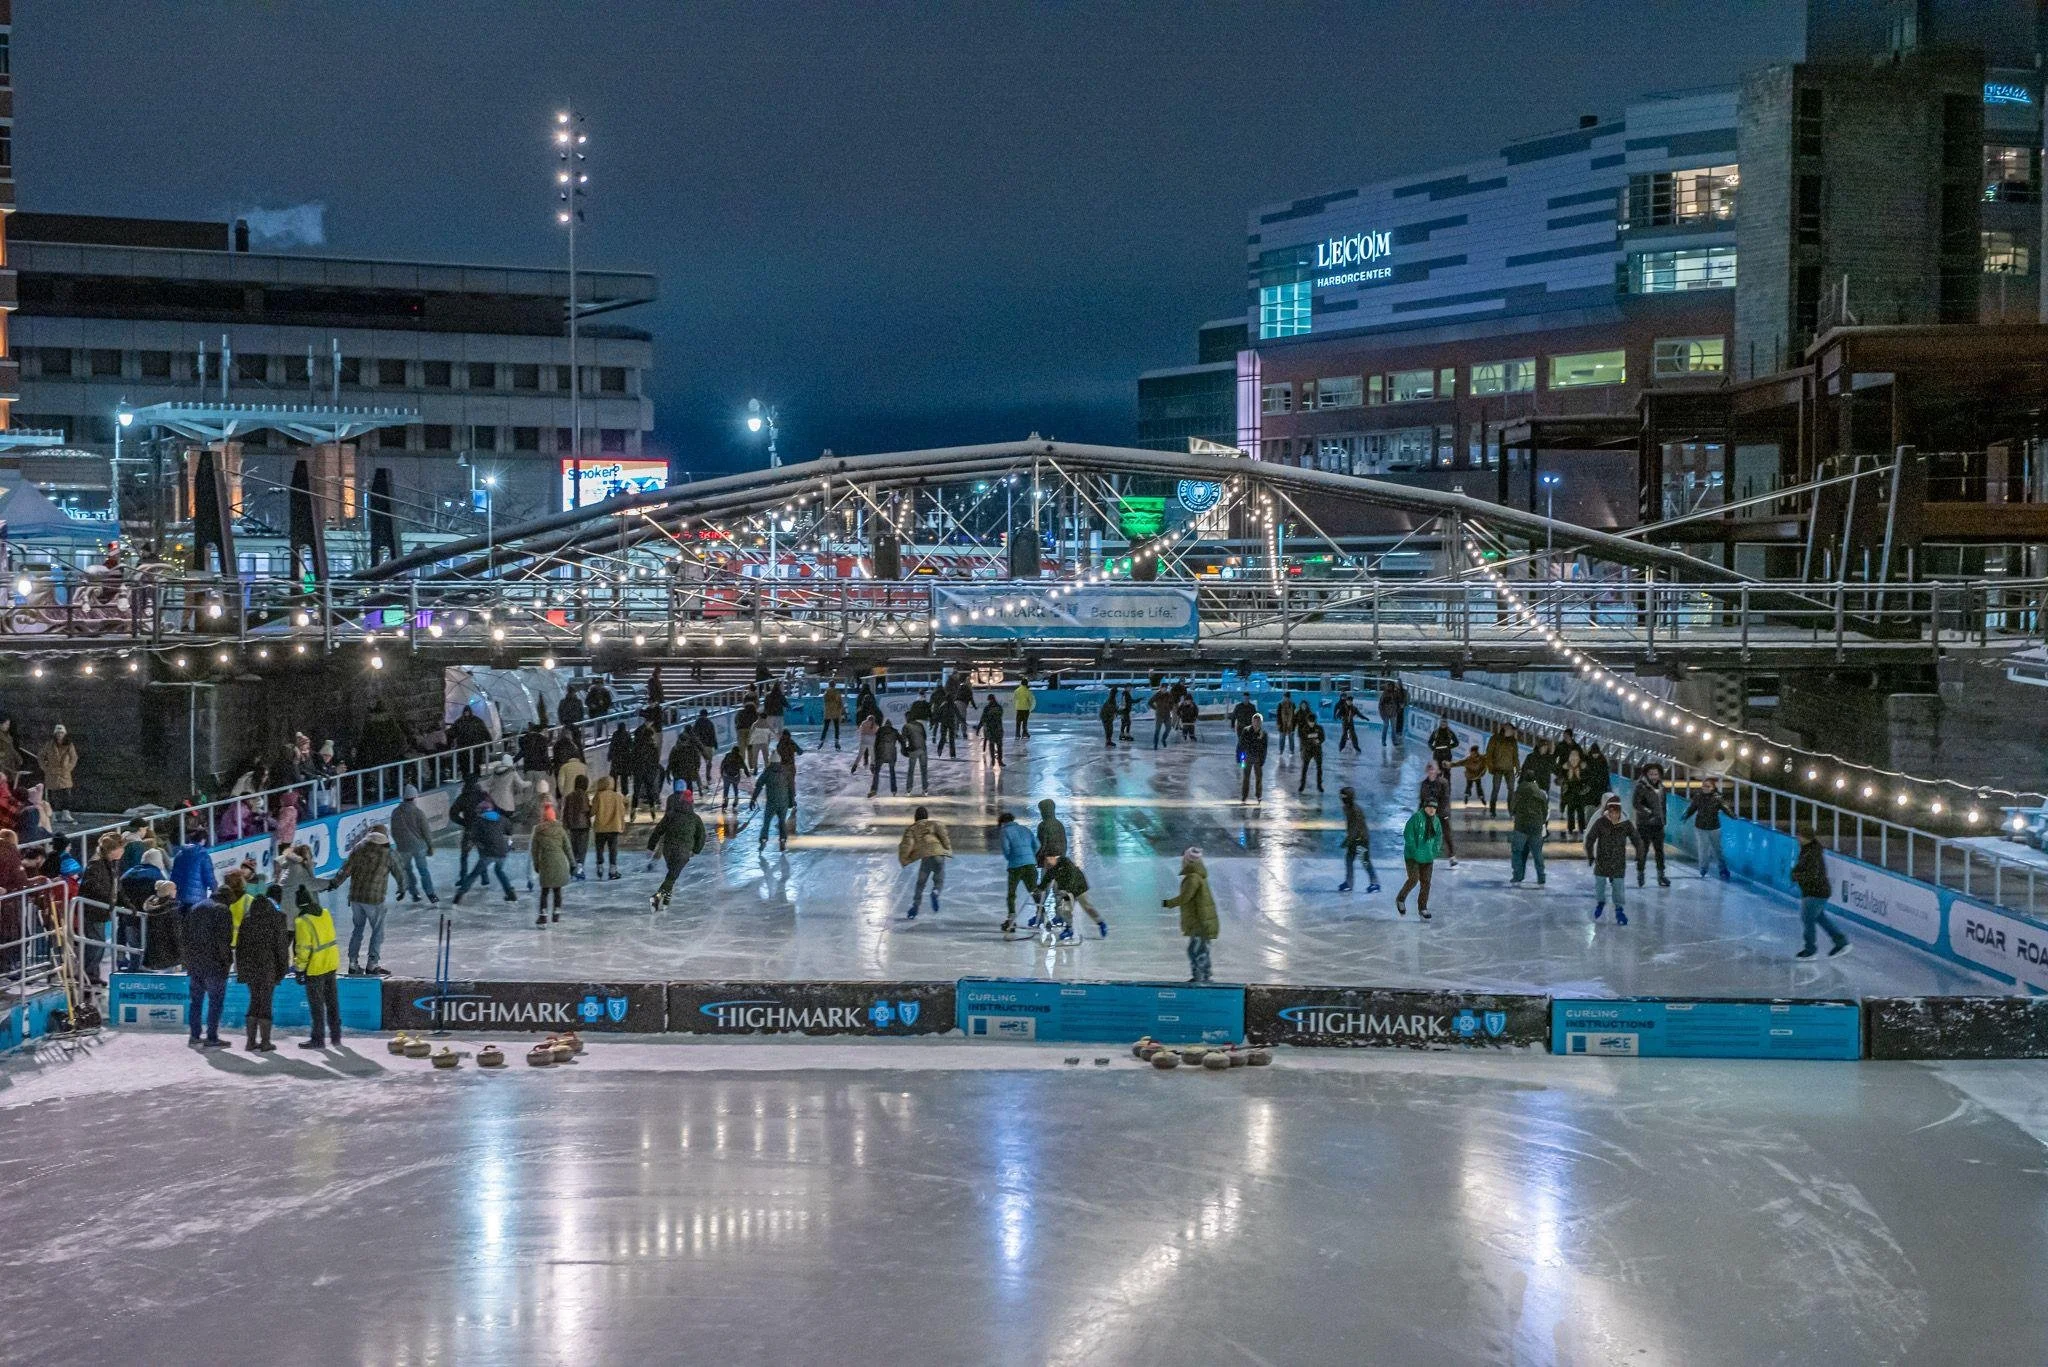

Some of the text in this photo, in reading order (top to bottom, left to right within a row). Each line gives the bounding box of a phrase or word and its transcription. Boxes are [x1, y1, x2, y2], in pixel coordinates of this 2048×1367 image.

[1317, 267, 1391, 287] HARBORCENTER
[1091, 606, 1144, 618] Because
[1965, 919, 2048, 965] ROAR ROA
[118, 982, 168, 991] CURLING
[118, 992, 190, 1000] INSTRUCTION
[967, 992, 1017, 1002] CURLING
[430, 1001, 571, 1023] HIGHMARK
[967, 1003, 1052, 1014] INSTRUCTIONS
[1565, 1009, 1619, 1019] CURLING
[717, 1006, 863, 1028] HIGHMARK
[1296, 1011, 1446, 1037] HIGHMARK
[1565, 1019, 1655, 1030] INSTRUCTIONS
